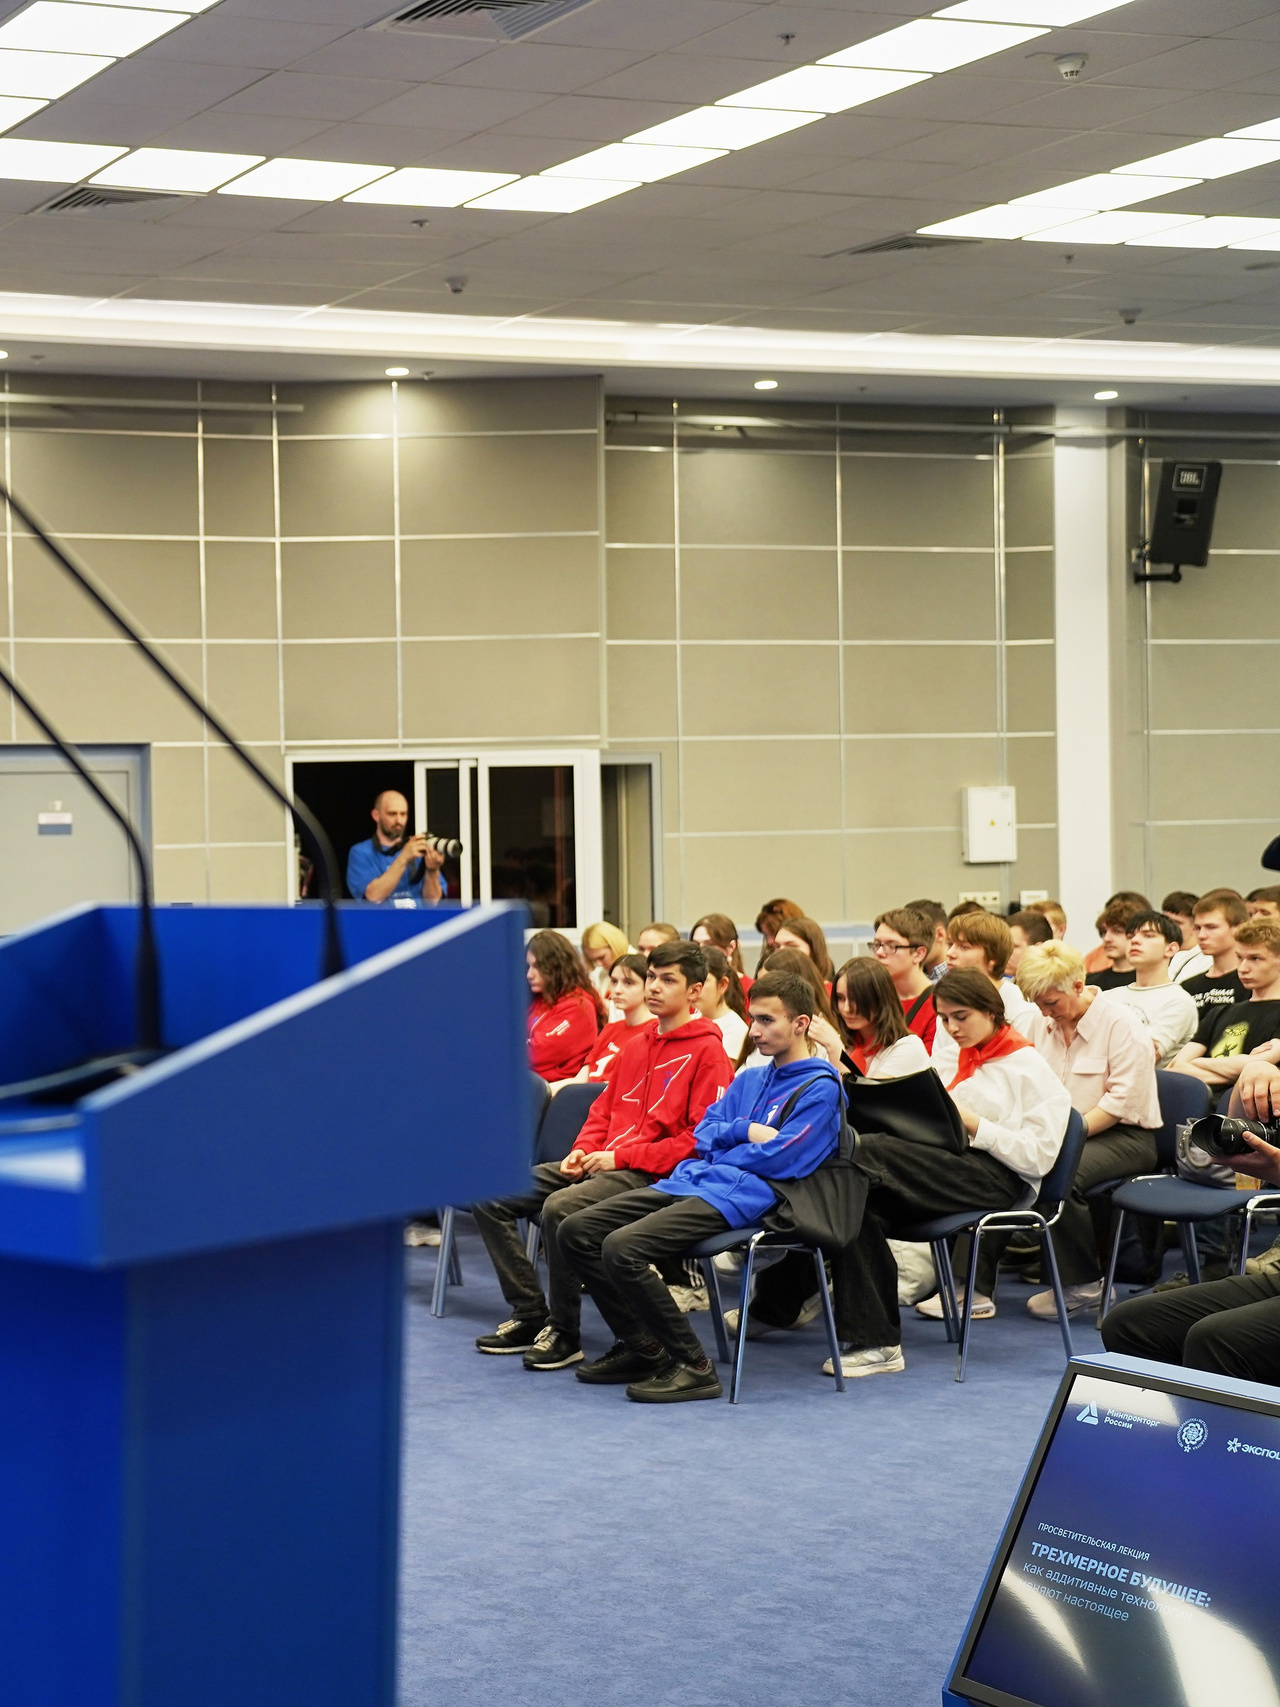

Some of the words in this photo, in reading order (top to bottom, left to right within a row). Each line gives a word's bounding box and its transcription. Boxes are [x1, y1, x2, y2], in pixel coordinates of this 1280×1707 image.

[1104, 1416, 1133, 1430] России
[1106, 1409, 1161, 1428] Минпромторг
[1037, 1522, 1117, 1552] ПРОСВЕТИТЕЛЬСКАЯ
[1116, 1545, 1151, 1562] ЛЕКЦИЯ
[1023, 1562, 1045, 1578] как
[1045, 1569, 1118, 1599] аддитивные
[1121, 1591, 1193, 1621] технологии
[1031, 1541, 1130, 1583] ТРЕХМЕРНОЕ
[1129, 1571, 1212, 1608] БУДУЩЕЕ:
[1017, 1579, 1063, 1600] меняют
[1063, 1595, 1129, 1622] настоящее
